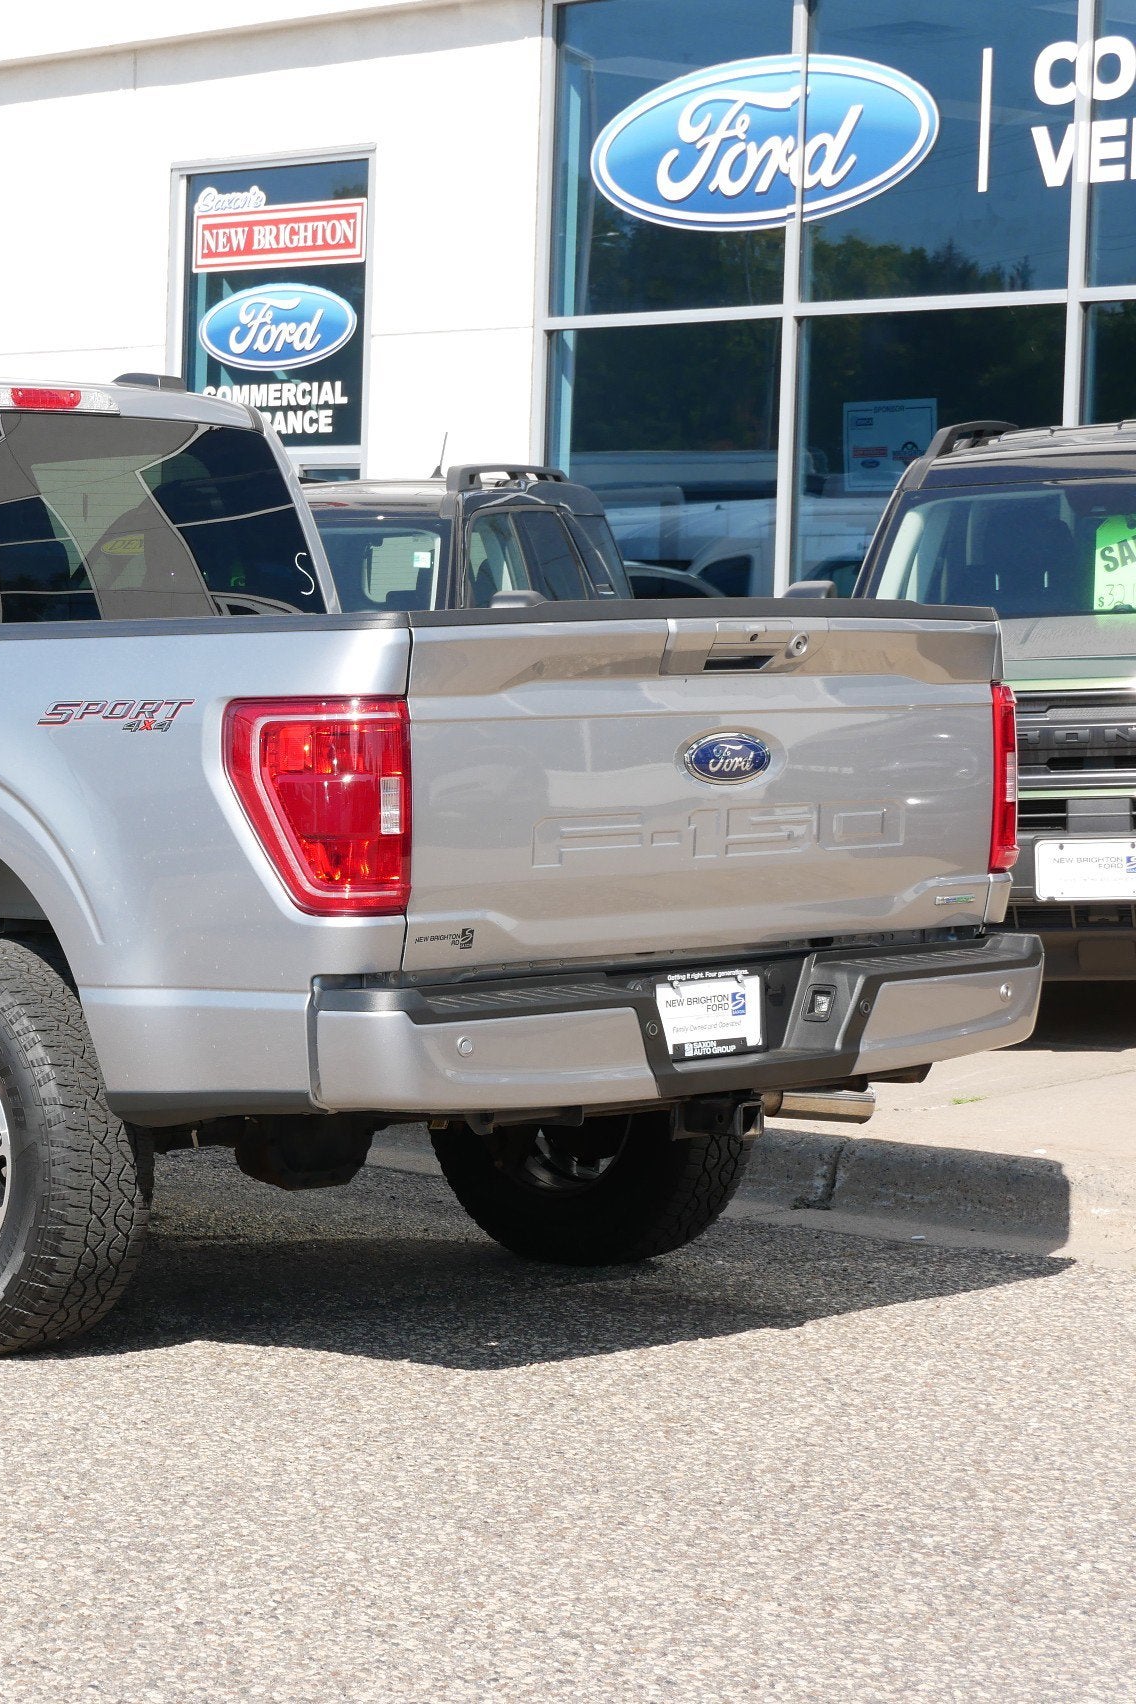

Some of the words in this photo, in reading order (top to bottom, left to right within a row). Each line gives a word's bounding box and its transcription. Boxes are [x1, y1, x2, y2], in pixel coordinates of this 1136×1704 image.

[656, 87, 865, 201] Ford
[1030, 118, 1136, 188] VE
[198, 187, 264, 212] Saxon's
[202, 227, 248, 254] NEW
[252, 218, 356, 251] BRIGHTON
[229, 296, 325, 354] Ford
[1100, 534, 1136, 572] SA
[37, 699, 195, 726] SPORT
[709, 744, 754, 774] Ford
[532, 802, 904, 868] F-150
[1076, 856, 1123, 864] BRIGHTON
[429, 933, 461, 942] BRIGHTON
[665, 999, 685, 1008] NEW
[686, 994, 729, 1006] BRIGHTON
[706, 1002, 729, 1012] FORD
[672, 1025, 689, 1034] Family
[693, 1047, 711, 1055] AUTO
[712, 1045, 736, 1054] GROUP
